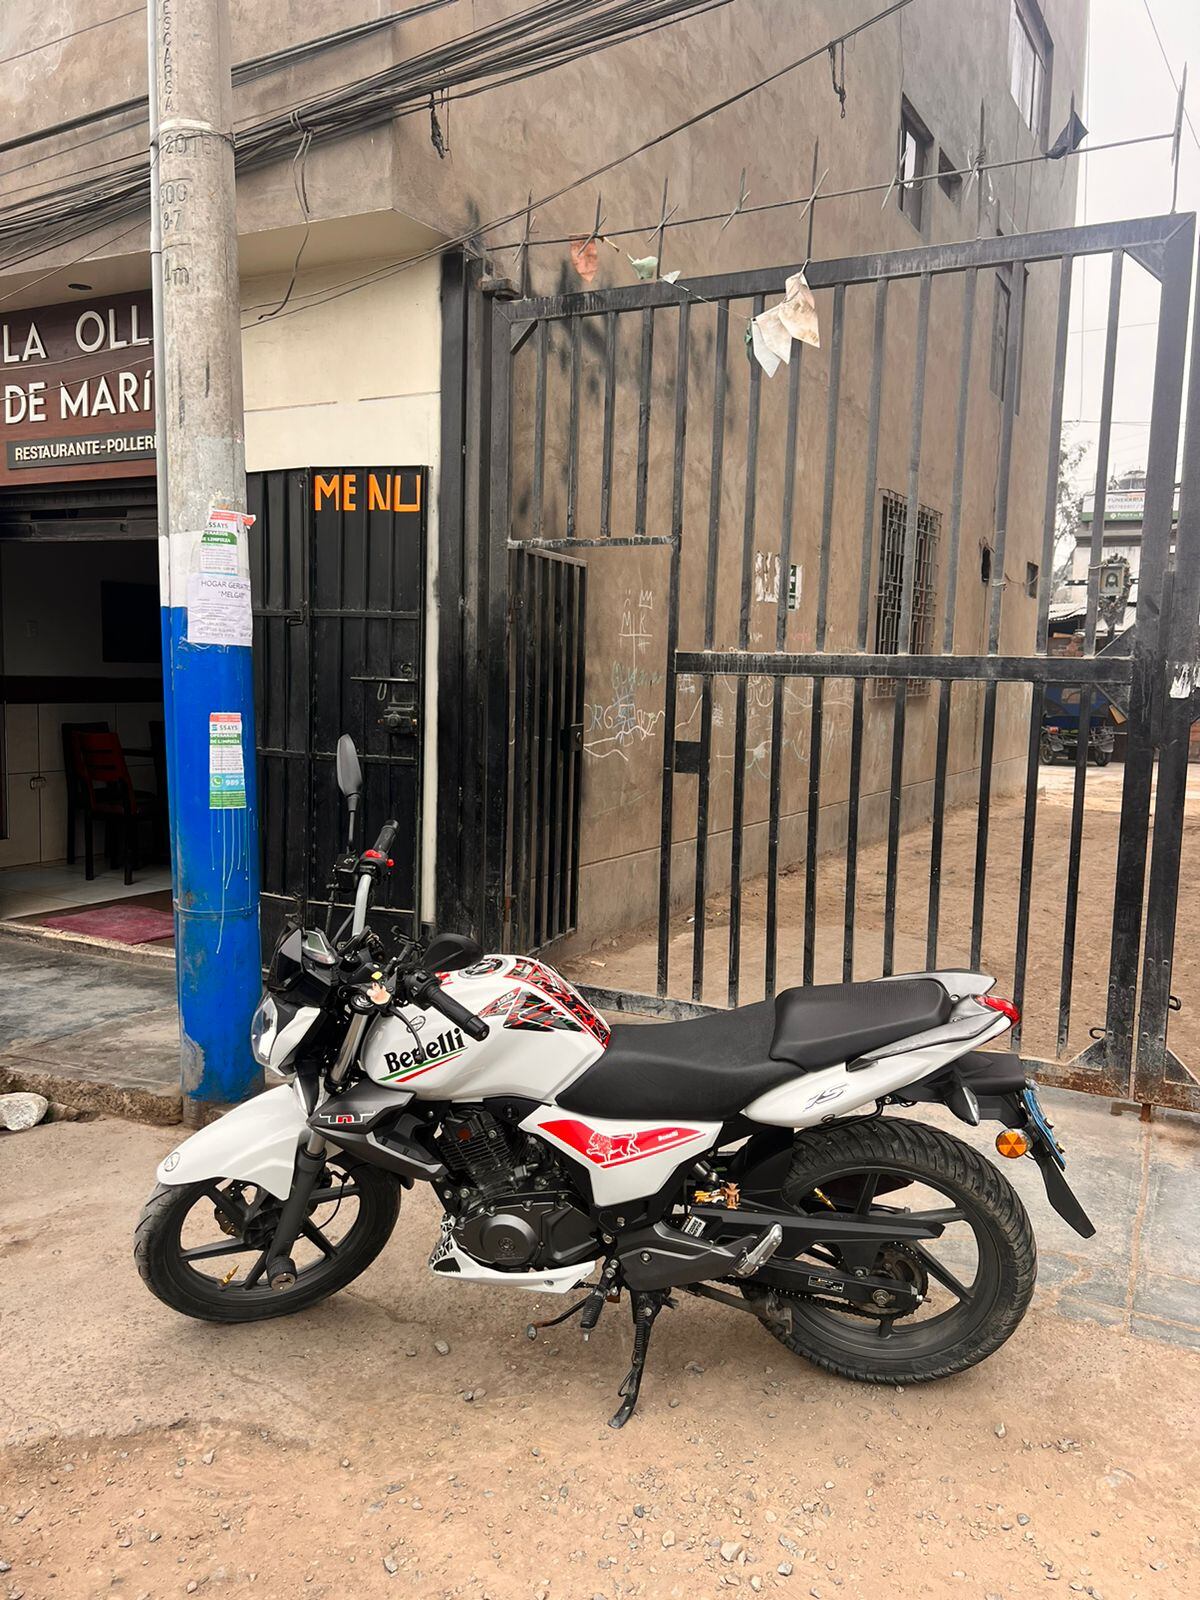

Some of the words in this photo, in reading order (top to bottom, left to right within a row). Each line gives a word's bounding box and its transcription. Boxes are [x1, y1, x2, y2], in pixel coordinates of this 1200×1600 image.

[3, 322, 47, 363] LA
[75, 305, 150, 353] OLL
[5, 382, 46, 424] DE
[60, 370, 152, 419] MARÍ
[201, 580, 227, 588] HOGAR
